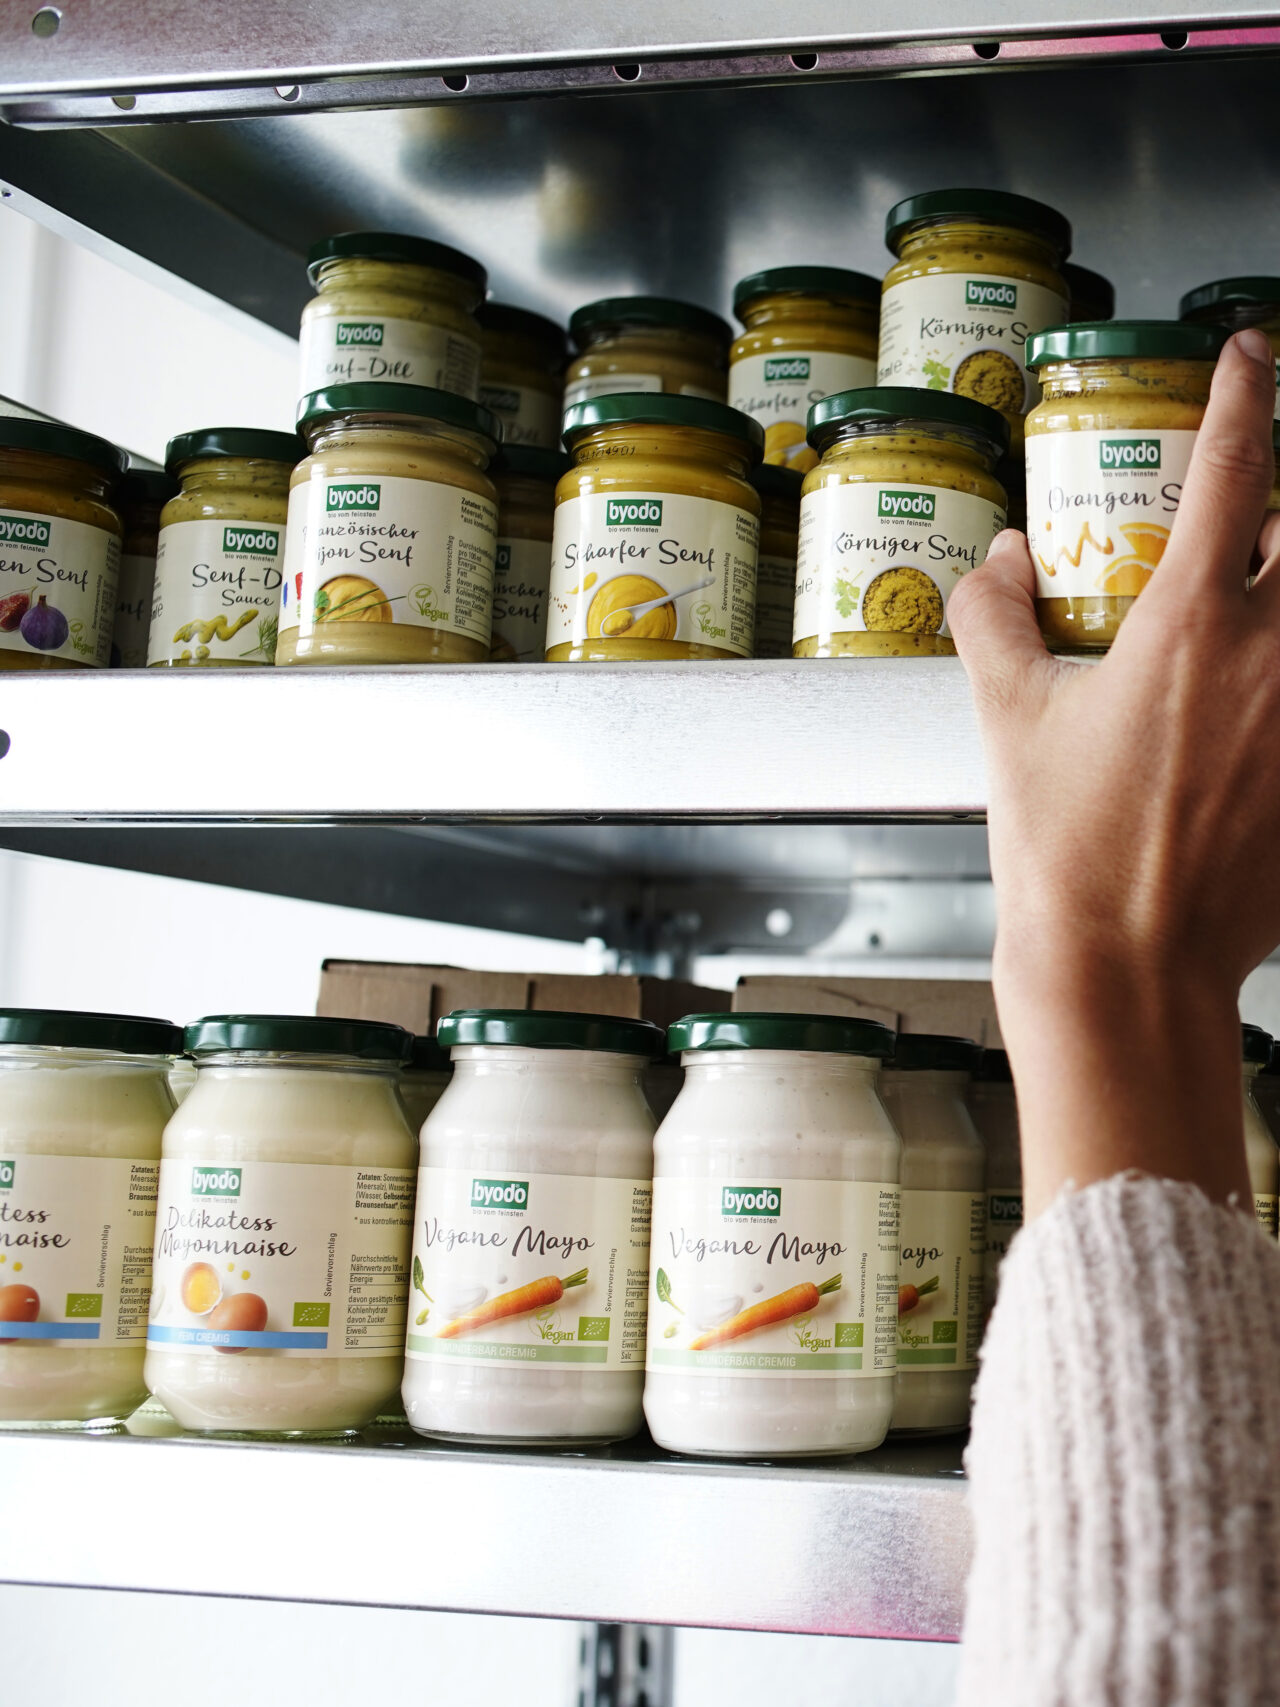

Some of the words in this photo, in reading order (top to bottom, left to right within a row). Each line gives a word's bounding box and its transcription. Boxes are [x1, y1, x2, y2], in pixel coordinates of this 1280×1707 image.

[968, 283, 1015, 303] byodo
[338, 323, 383, 345] byodo
[920, 317, 1008, 342] Körniger
[325, 357, 414, 378] enf-Dill
[767, 360, 810, 379] byodo
[1101, 442, 1159, 467] byodo
[328, 487, 379, 509] byodo
[881, 493, 934, 515] byodo
[1049, 487, 1156, 514] Orangen
[609, 502, 661, 523] byodo
[906, 519, 932, 528] feinsten
[20, 544, 46, 553] feinsten
[226, 530, 278, 551] byodo
[834, 531, 924, 558] Körniger
[928, 534, 977, 569] Senf
[250, 554, 275, 563] feinsten
[360, 540, 414, 567] Senf
[564, 539, 651, 569] Scharfer
[658, 539, 716, 571] Senf
[36, 558, 89, 592] Senf
[444, 535, 455, 595] Serviervorschlag
[721, 552, 731, 612] Serviervorschlag
[222, 589, 274, 607] Sauce
[416, 602, 449, 622] Vegan
[698, 617, 726, 639] Vegan
[131, 1165, 155, 1175] Zutaten:
[193, 1168, 239, 1192] byodo
[357, 1172, 382, 1181] Zutaten:
[356, 1191, 382, 1201] (Wasser,
[474, 1182, 526, 1206] byodo
[724, 1190, 779, 1213] byodo
[0, 1202, 52, 1223] tess
[168, 1206, 278, 1232] Delikatess
[498, 1209, 524, 1217] feinsten
[750, 1216, 777, 1224] feinsten
[158, 1230, 298, 1260] Mayonnaise
[424, 1217, 508, 1252] Vegane
[512, 1225, 595, 1260] Mayo
[669, 1228, 761, 1262] Vegane
[766, 1232, 847, 1265] Mayo
[97, 1224, 111, 1288] Serviervorschlag
[324, 1232, 338, 1297] Serviervorschlag
[351, 1254, 398, 1263] Durchschnittliche
[122, 1266, 145, 1275] Energie
[350, 1263, 382, 1271] Nährwerte
[349, 1274, 374, 1285] Energie
[605, 1248, 617, 1312] Serviervorschlag
[858, 1252, 868, 1317] Serviervorschlag
[348, 1295, 367, 1303] davon
[347, 1306, 388, 1316] Kohlenhydrate
[347, 1315, 366, 1324] davon
[367, 1315, 385, 1324] Zucker
[196, 1332, 230, 1343] CREMIG
[346, 1326, 367, 1335] Eiweiß
[537, 1323, 574, 1344] Vegan
[499, 1346, 537, 1358] CREMIG
[795, 1331, 831, 1352] Vegan
[696, 1356, 755, 1366] WUNDERBAR
[758, 1357, 796, 1367] CREMIG
